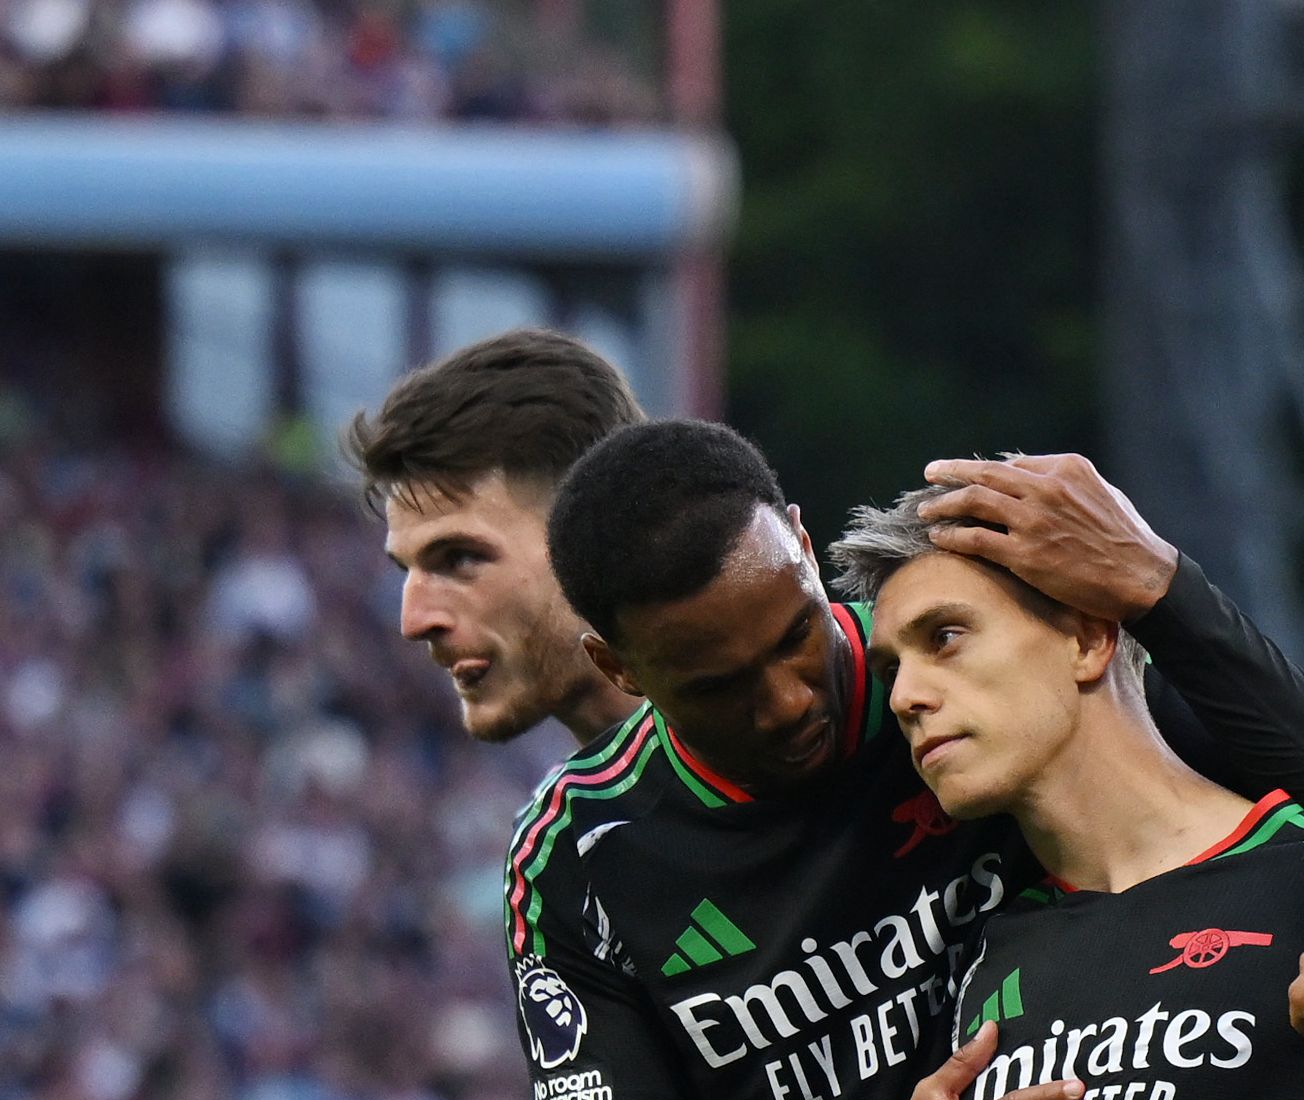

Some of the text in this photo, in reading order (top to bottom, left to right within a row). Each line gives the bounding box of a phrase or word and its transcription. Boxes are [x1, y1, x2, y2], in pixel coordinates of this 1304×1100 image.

[669, 853, 1004, 1069] Emirates
[534, 1069, 602, 1100] No room
